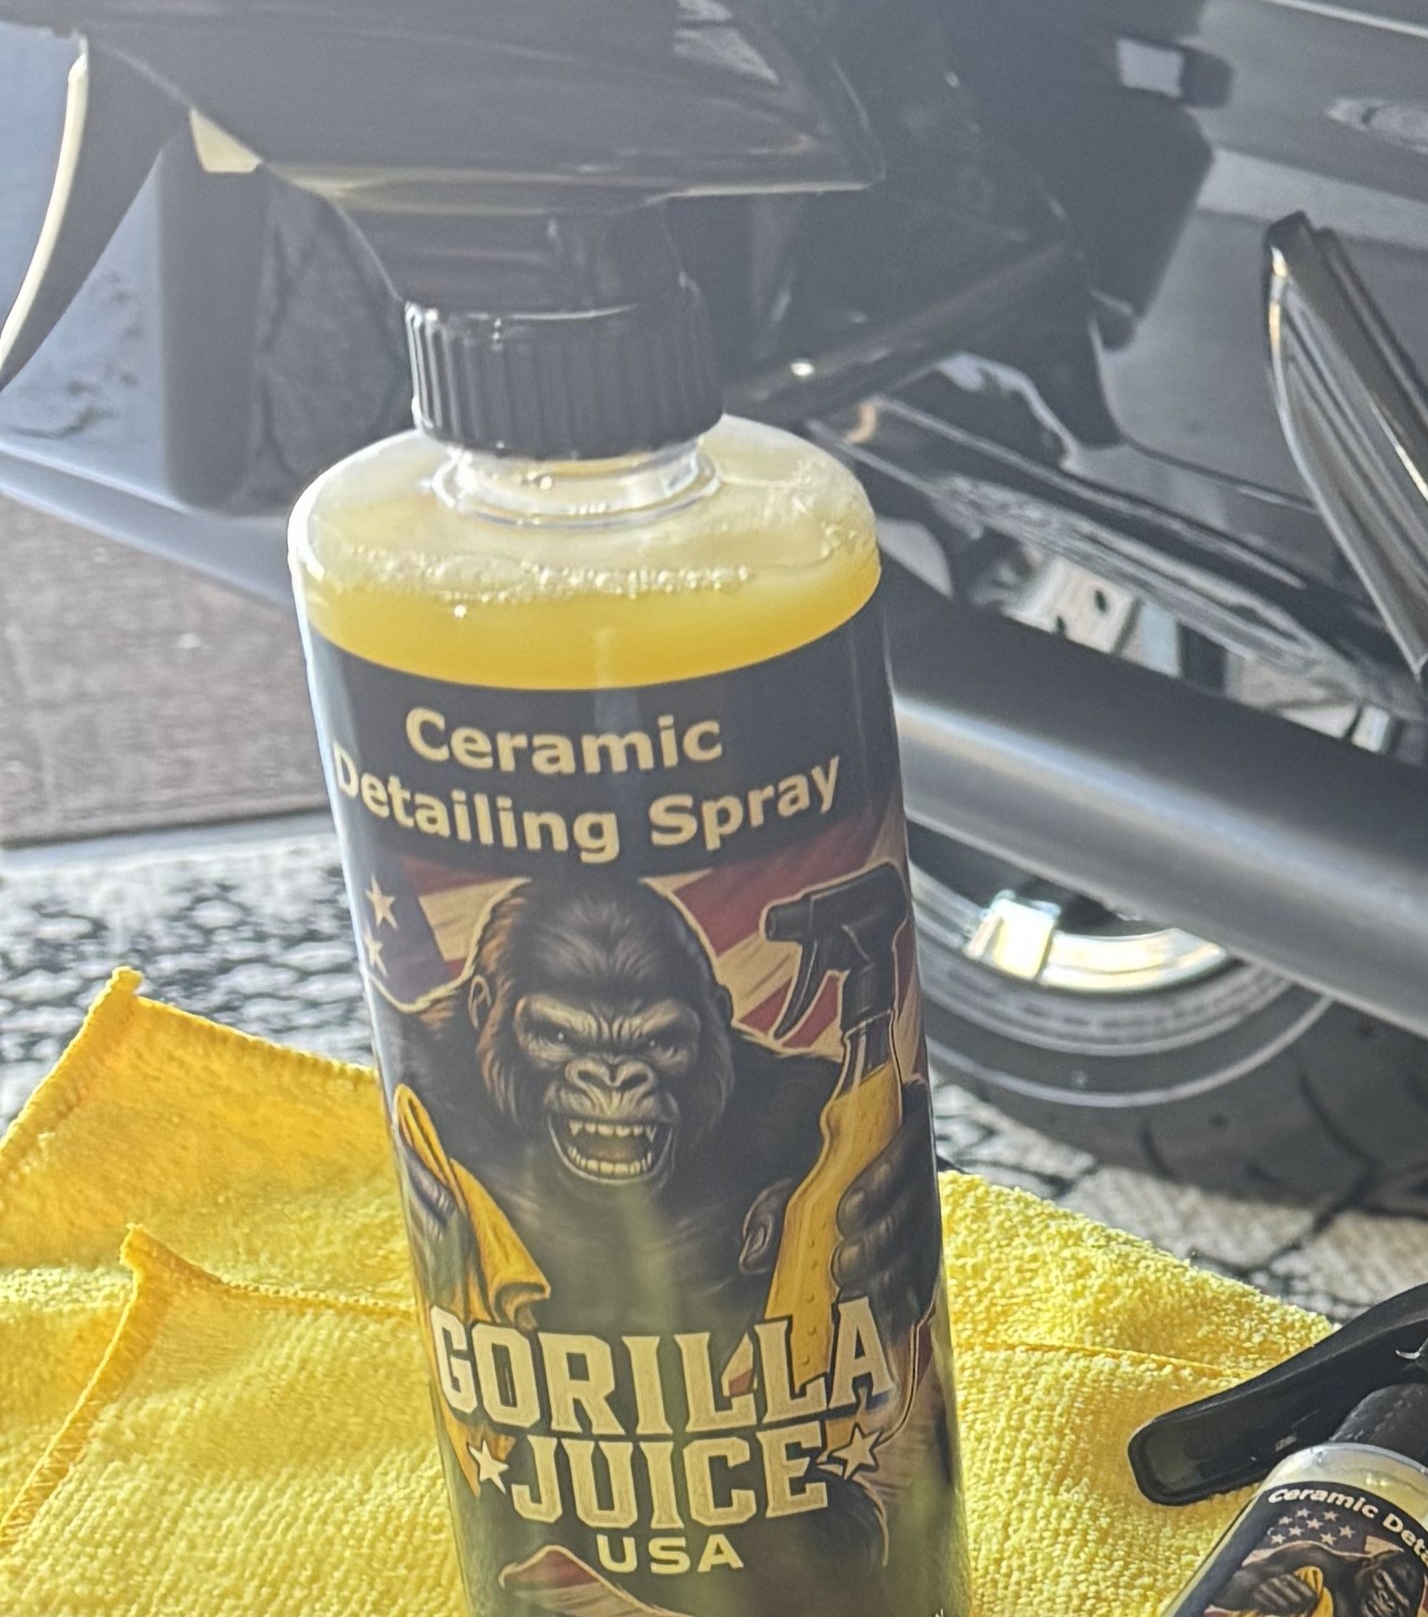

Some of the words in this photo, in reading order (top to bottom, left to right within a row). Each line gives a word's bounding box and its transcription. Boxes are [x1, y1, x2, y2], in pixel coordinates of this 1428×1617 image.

[405, 707, 723, 775] Ceramic
[331, 742, 621, 864] Detailing
[650, 754, 841, 850] Spray
[430, 1297, 895, 1434] GORILLA
[511, 1419, 829, 1530] JUICE
[1267, 1487, 1379, 1520] Ceramic
[595, 1532, 745, 1575] USA
